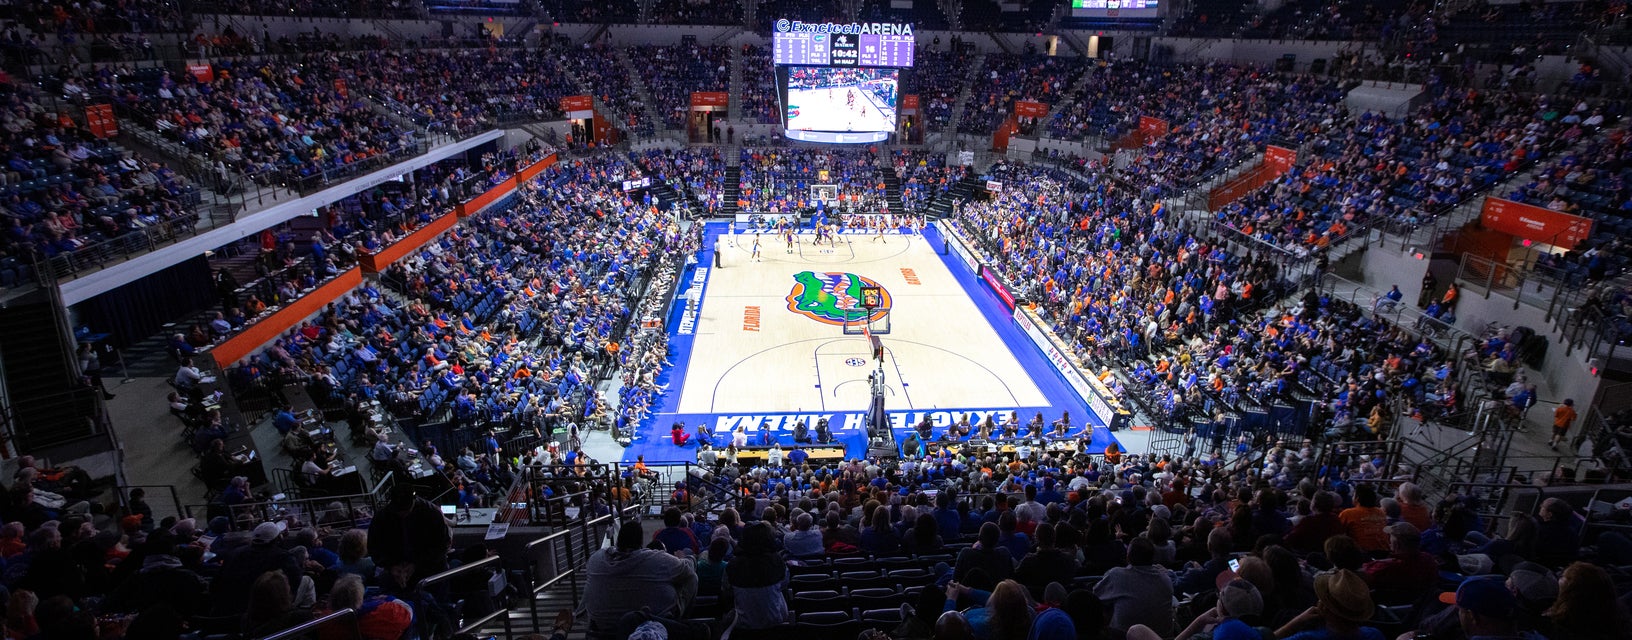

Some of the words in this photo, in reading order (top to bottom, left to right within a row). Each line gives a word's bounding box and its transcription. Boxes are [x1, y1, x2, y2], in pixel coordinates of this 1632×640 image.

[791, 21, 860, 34] Exactech
[860, 22, 912, 35] ARENA
[814, 44, 824, 52] 12
[832, 50, 857, 58] 10:42
[743, 306, 761, 332] FLORIDA
[715, 414, 834, 432] ARENA
[840, 410, 1016, 430] EXACTEH
